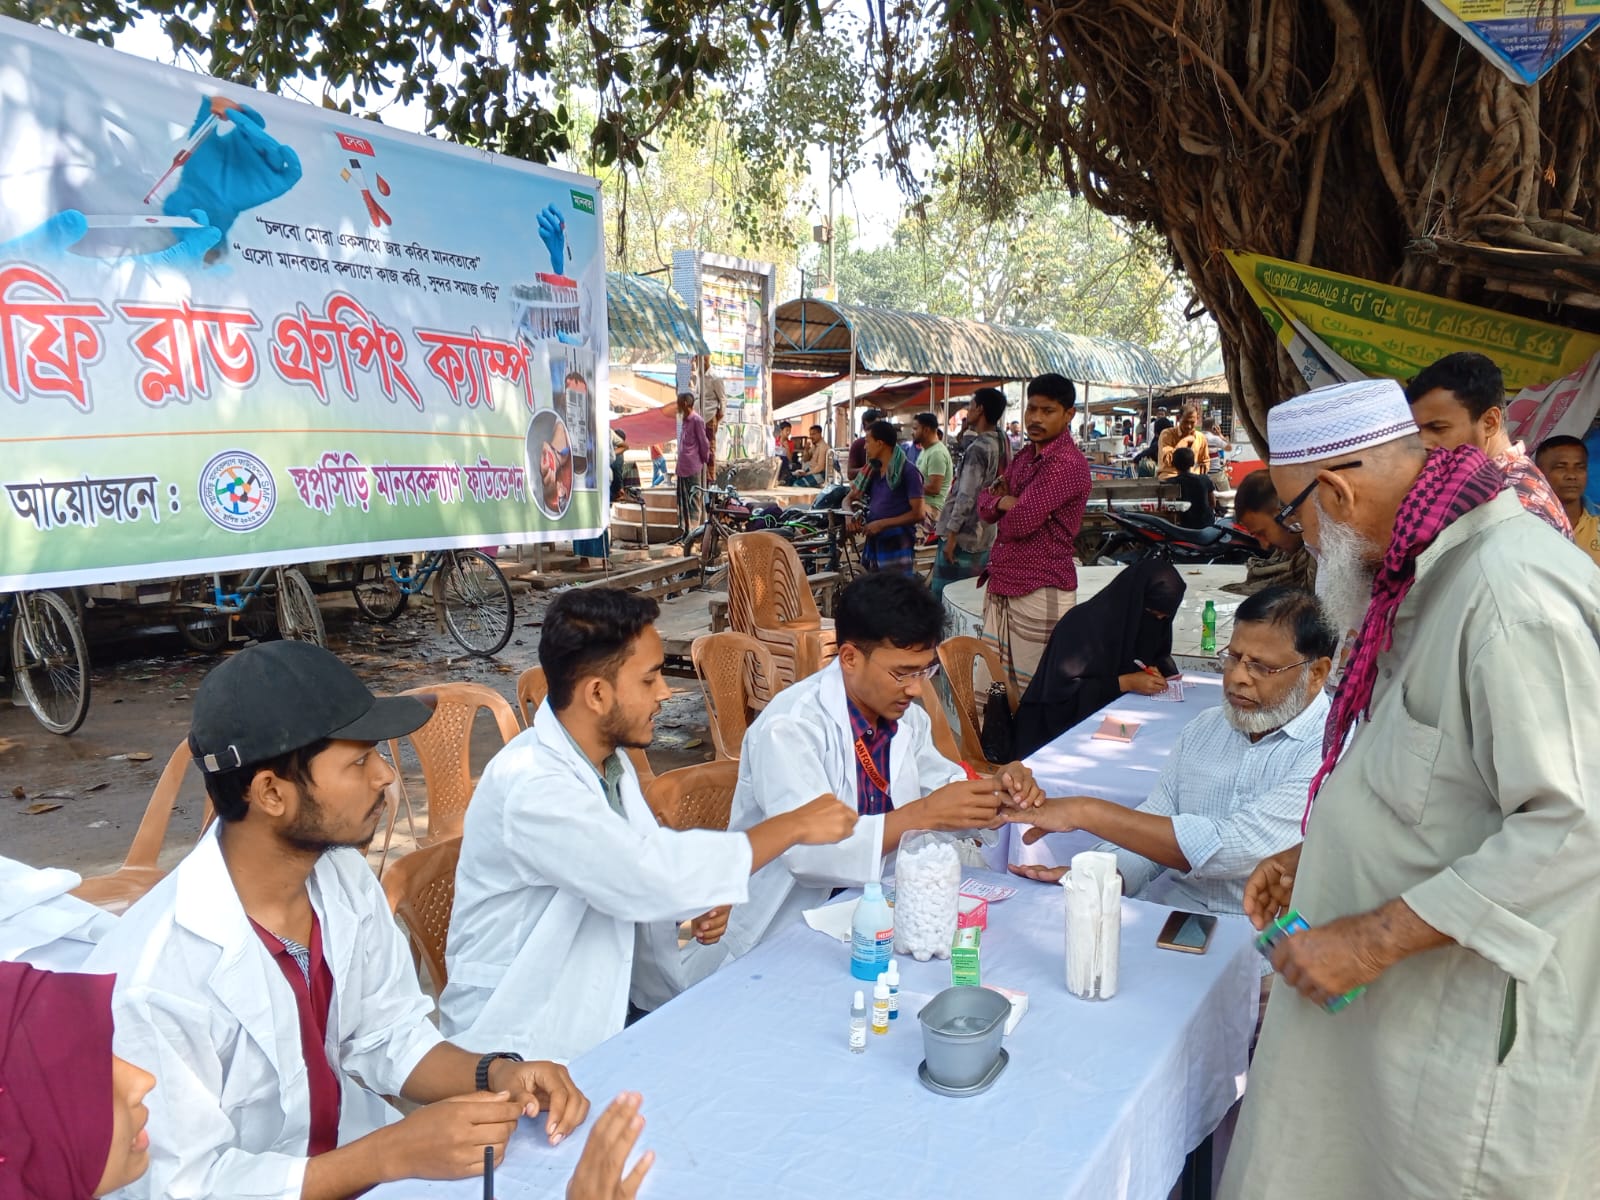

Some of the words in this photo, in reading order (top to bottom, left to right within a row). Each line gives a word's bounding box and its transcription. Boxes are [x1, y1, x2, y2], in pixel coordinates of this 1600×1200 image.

[343, 136, 367, 150] সেবা
[305, 227, 334, 247] মোরা
[337, 234, 381, 253] একসাথে
[383, 241, 402, 258] জয়
[403, 241, 431, 263] করিব
[276, 252, 329, 275] মানবতার
[331, 260, 373, 281] কল্যাণে
[374, 267, 400, 284] কাজ
[427, 275, 452, 294] সুন্দর
[453, 280, 479, 298] সমাজ
[0, 266, 108, 408] ফ্রি
[118, 299, 259, 403] ব্লাড
[272, 294, 423, 411] গ্রুপিং
[417, 329, 535, 411] ক্যাম্প
[4, 475, 159, 528] আয়োজনে
[261, 480, 270, 502] SMF
[287, 452, 370, 513] স্বপ্নসিঁড়ি
[371, 461, 463, 504] মানবকল্যাণ
[463, 455, 526, 504] ফাউন্ডেশন
